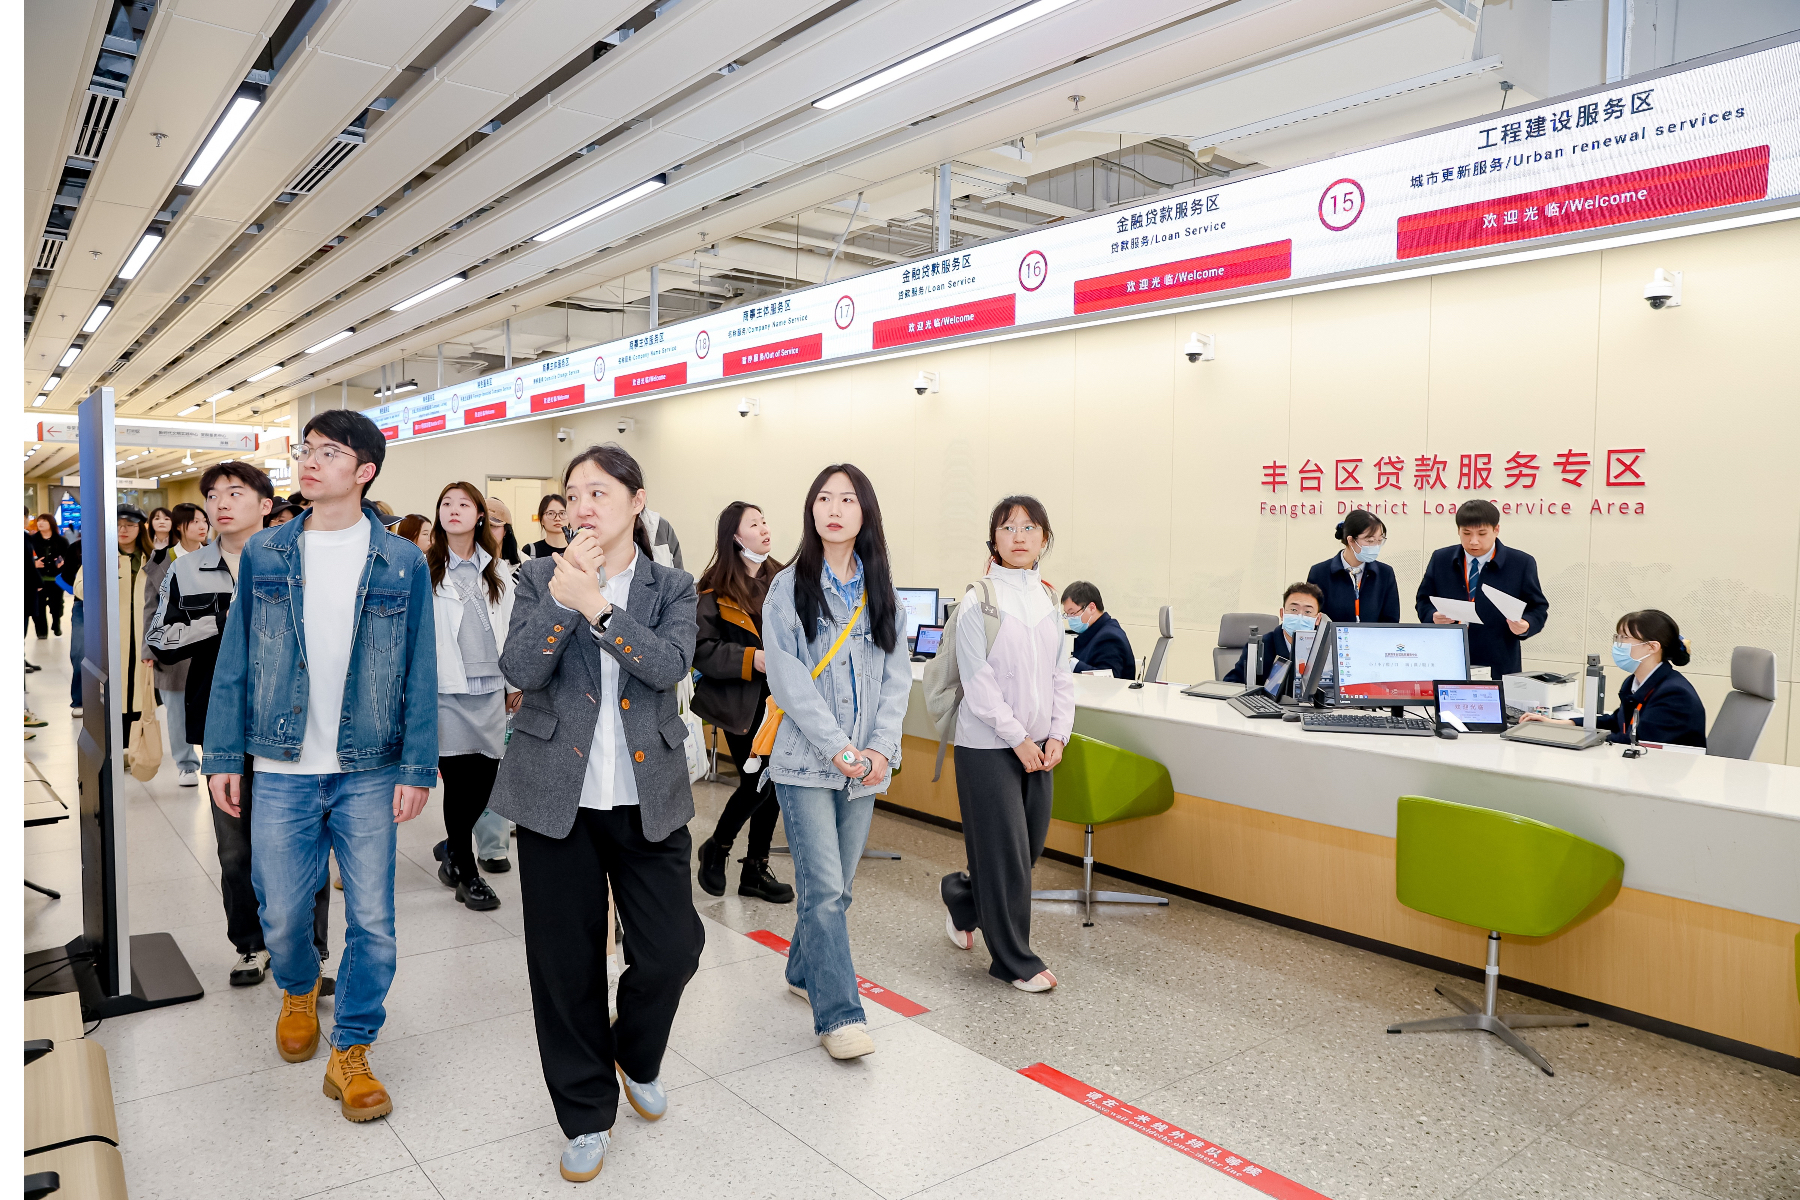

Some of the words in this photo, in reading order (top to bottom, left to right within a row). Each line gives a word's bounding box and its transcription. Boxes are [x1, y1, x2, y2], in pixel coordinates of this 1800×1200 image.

[1478, 88, 1655, 151] 工程建设服务区
[1410, 146, 1564, 189] 城市更新服务/Urban
[1572, 126, 1646, 154] renewal
[1655, 105, 1746, 136] services
[1116, 194, 1220, 234] 金融贷款服务区
[1330, 191, 1354, 215] 15
[1110, 231, 1181, 254] 贷款服务/Loan
[1184, 220, 1227, 237] Service
[902, 253, 972, 283] 金融贷款服务区
[947, 275, 976, 288] Service
[1025, 260, 1041, 279] 16
[839, 304, 851, 319] 17
[1261, 448, 1646, 493] 丰台区贷款服务专区
[1260, 500, 1324, 518] Fengtai
[1337, 499, 1408, 515] District
[1423, 500, 1458, 515] Loa
[1589, 498, 1646, 515] Area
